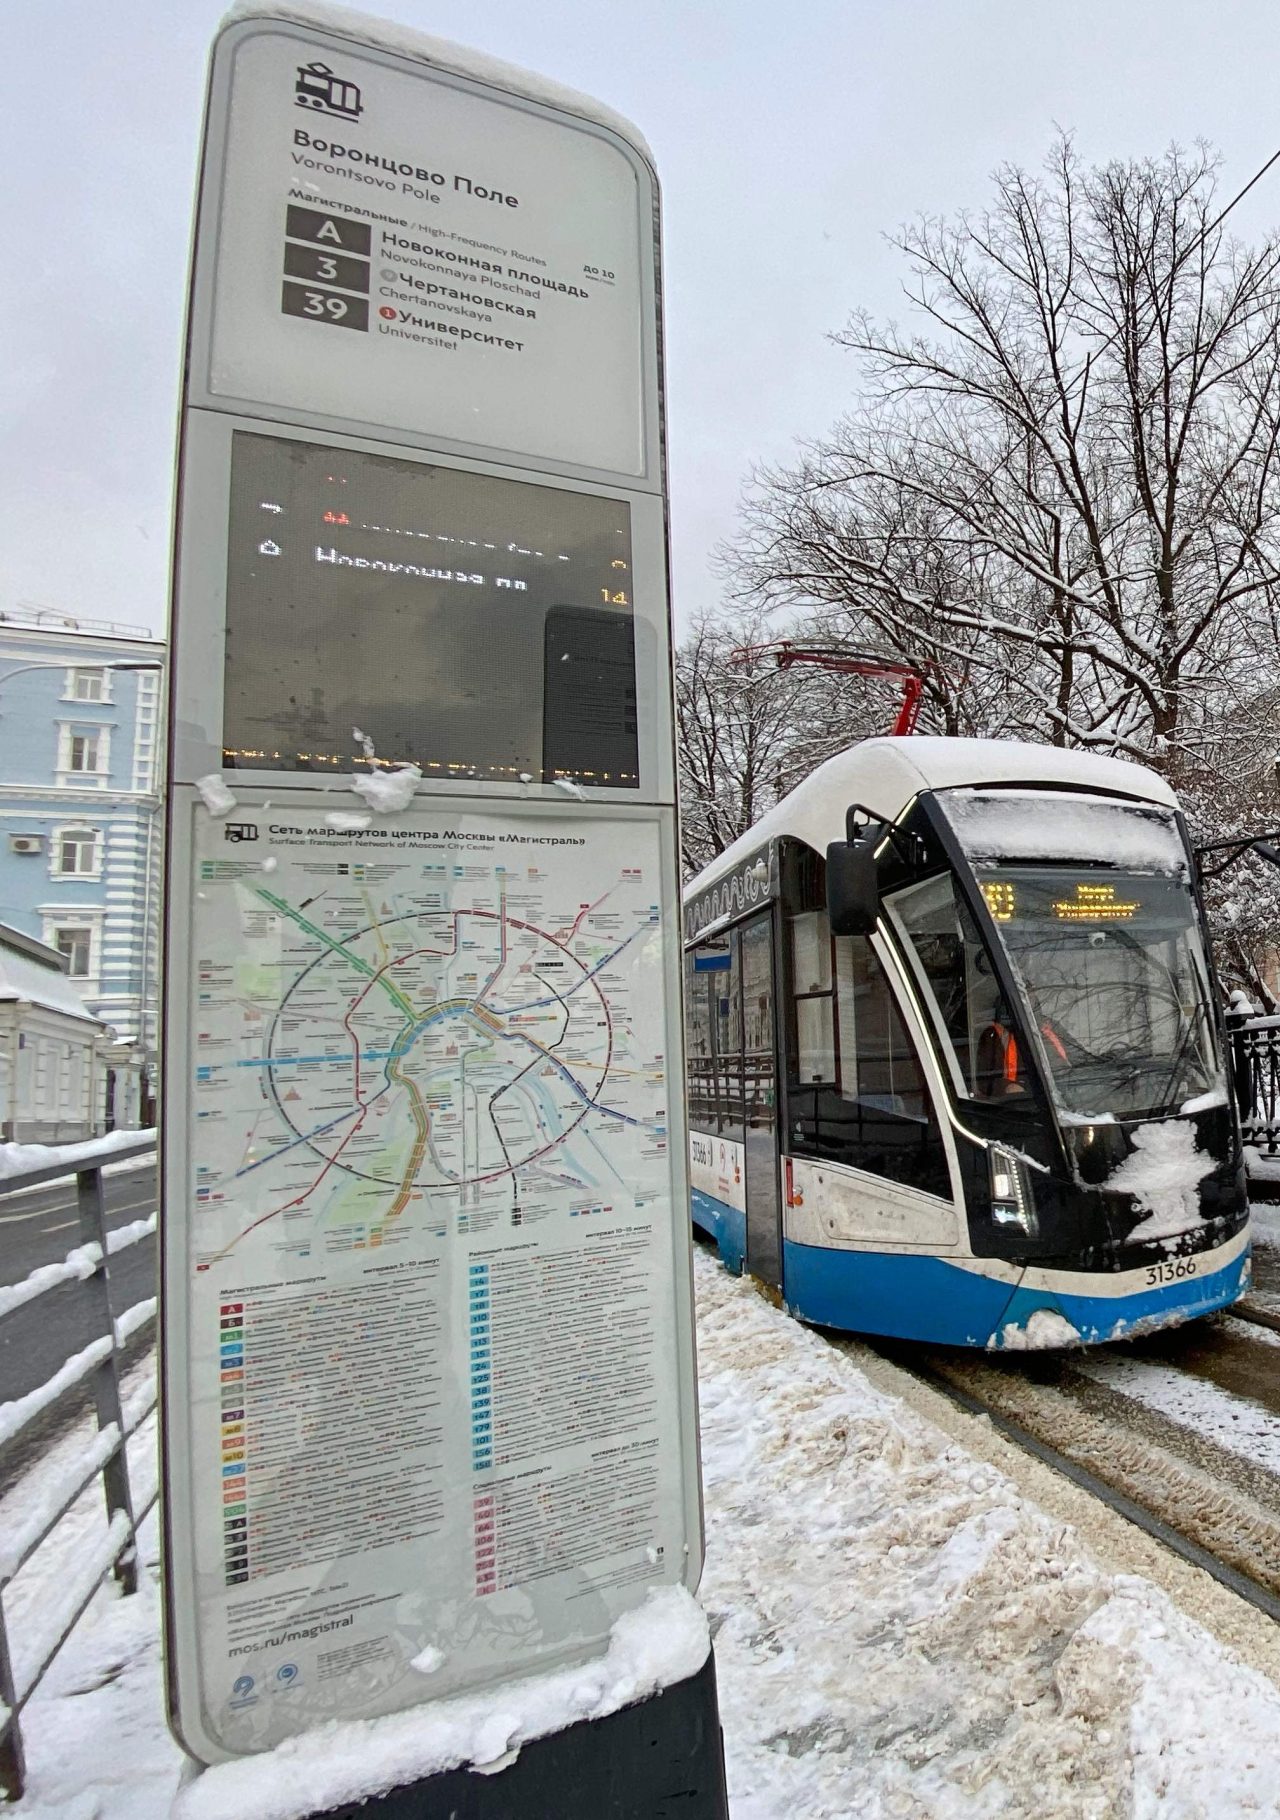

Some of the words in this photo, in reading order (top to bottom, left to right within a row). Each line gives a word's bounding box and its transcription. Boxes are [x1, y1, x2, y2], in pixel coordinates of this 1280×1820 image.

[291, 152, 396, 191] Vorontsovo
[402, 183, 441, 204] Pole
[294, 129, 445, 186] Воронцово
[454, 175, 519, 208] Поле
[288, 188, 408, 227] Магистральные
[418, 223, 508, 257] High-Frequency
[511, 250, 547, 267] Routes
[316, 256, 338, 279] 3
[380, 249, 477, 283] Novokonnaya
[481, 274, 541, 300] Ploschad
[382, 231, 502, 275] Новоконная
[508, 267, 589, 299] площадь
[303, 292, 348, 320] 39
[379, 286, 492, 323] Chertanovskaya
[400, 272, 536, 319] Чертановская
[378, 323, 457, 350] Universitet
[399, 309, 524, 351] Университет
[269, 825, 303, 835] Сеть
[307, 827, 388, 839] маршрутов
[391, 830, 439, 839] центра
[443, 830, 496, 842] Москвы
[499, 834, 586, 846] «Магистраль»
[269, 837, 306, 846] Surface
[309, 839, 352, 848] Transport
[355, 840, 396, 848] Network
[447, 843, 464, 851] City
[1146, 1257, 1196, 1285] 31366
